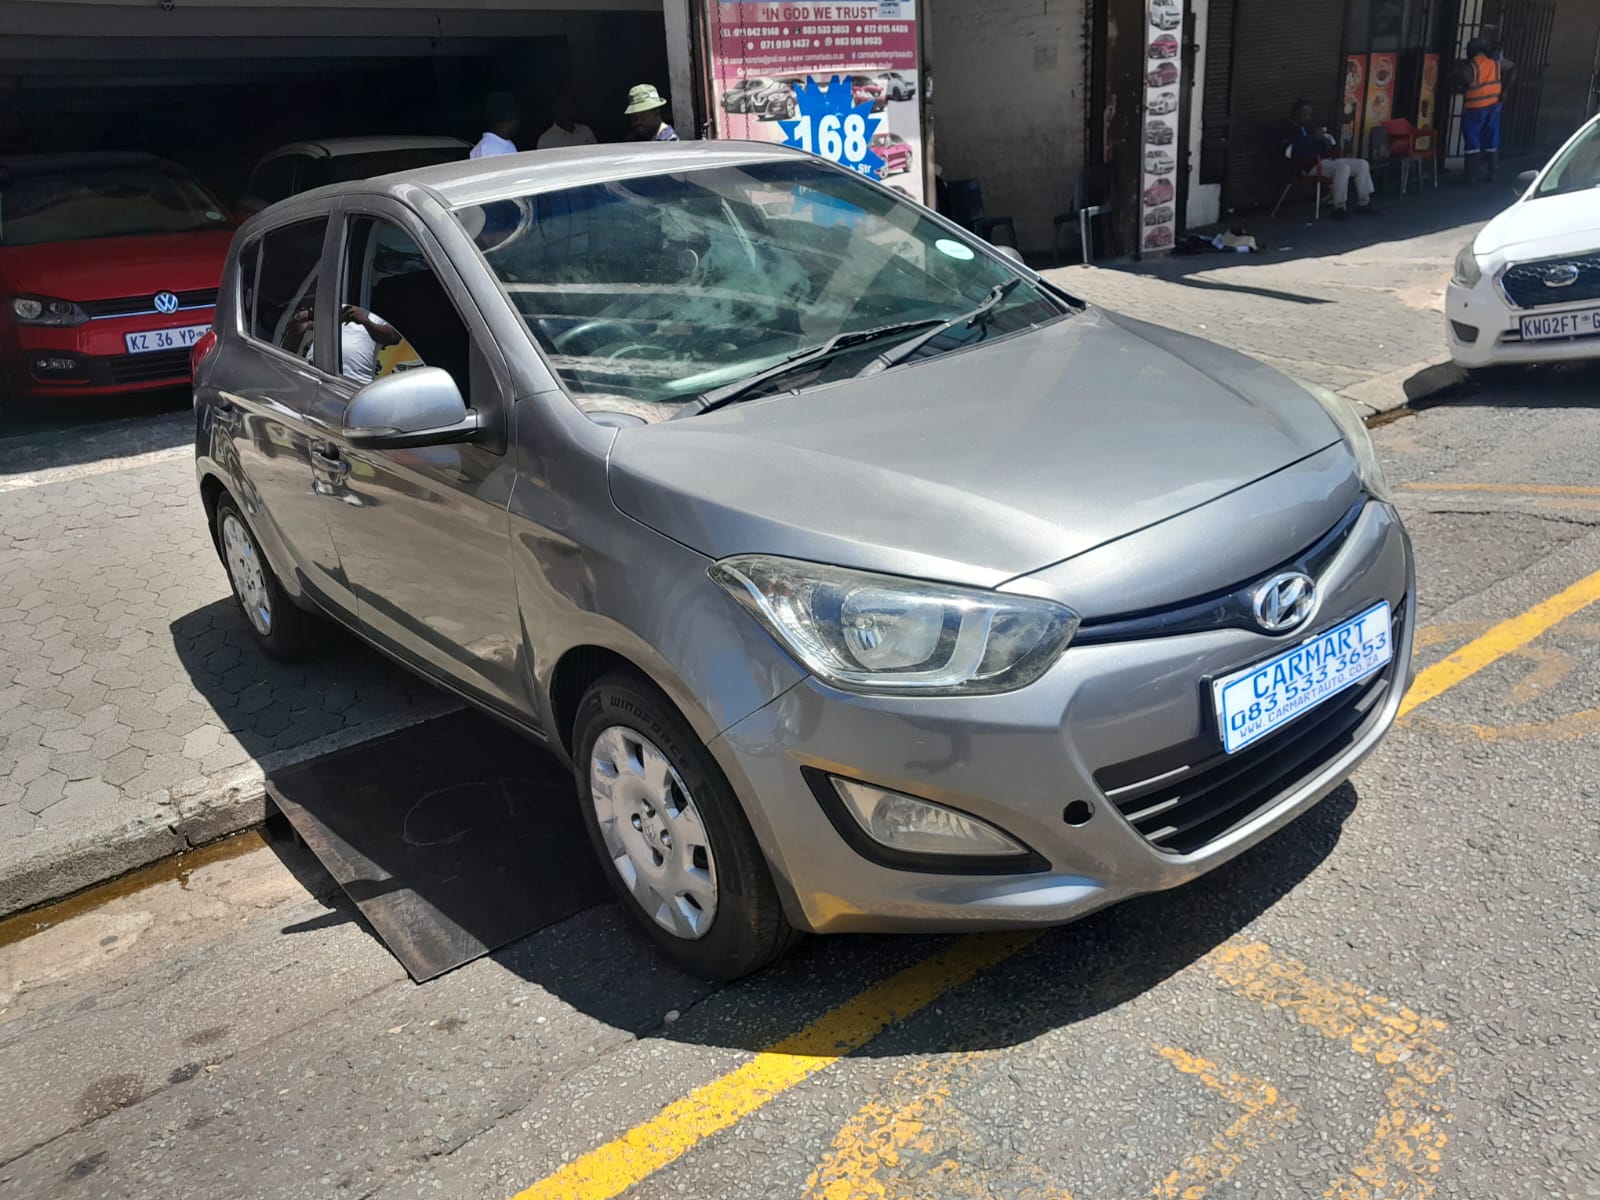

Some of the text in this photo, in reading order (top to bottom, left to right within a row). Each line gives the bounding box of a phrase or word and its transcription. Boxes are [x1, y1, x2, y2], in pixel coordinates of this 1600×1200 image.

[762, 8, 779, 20] 'IN
[784, 8, 809, 20] GOD
[814, 7, 832, 19] WE
[836, 6, 877, 19] TRUST'
[794, 113, 868, 163] 168
[130, 329, 196, 351] KZ 36 YP
[1523, 314, 1579, 337] KW02FT
[1253, 619, 1366, 699] CARMART
[1231, 632, 1387, 731] 083 533 3653
